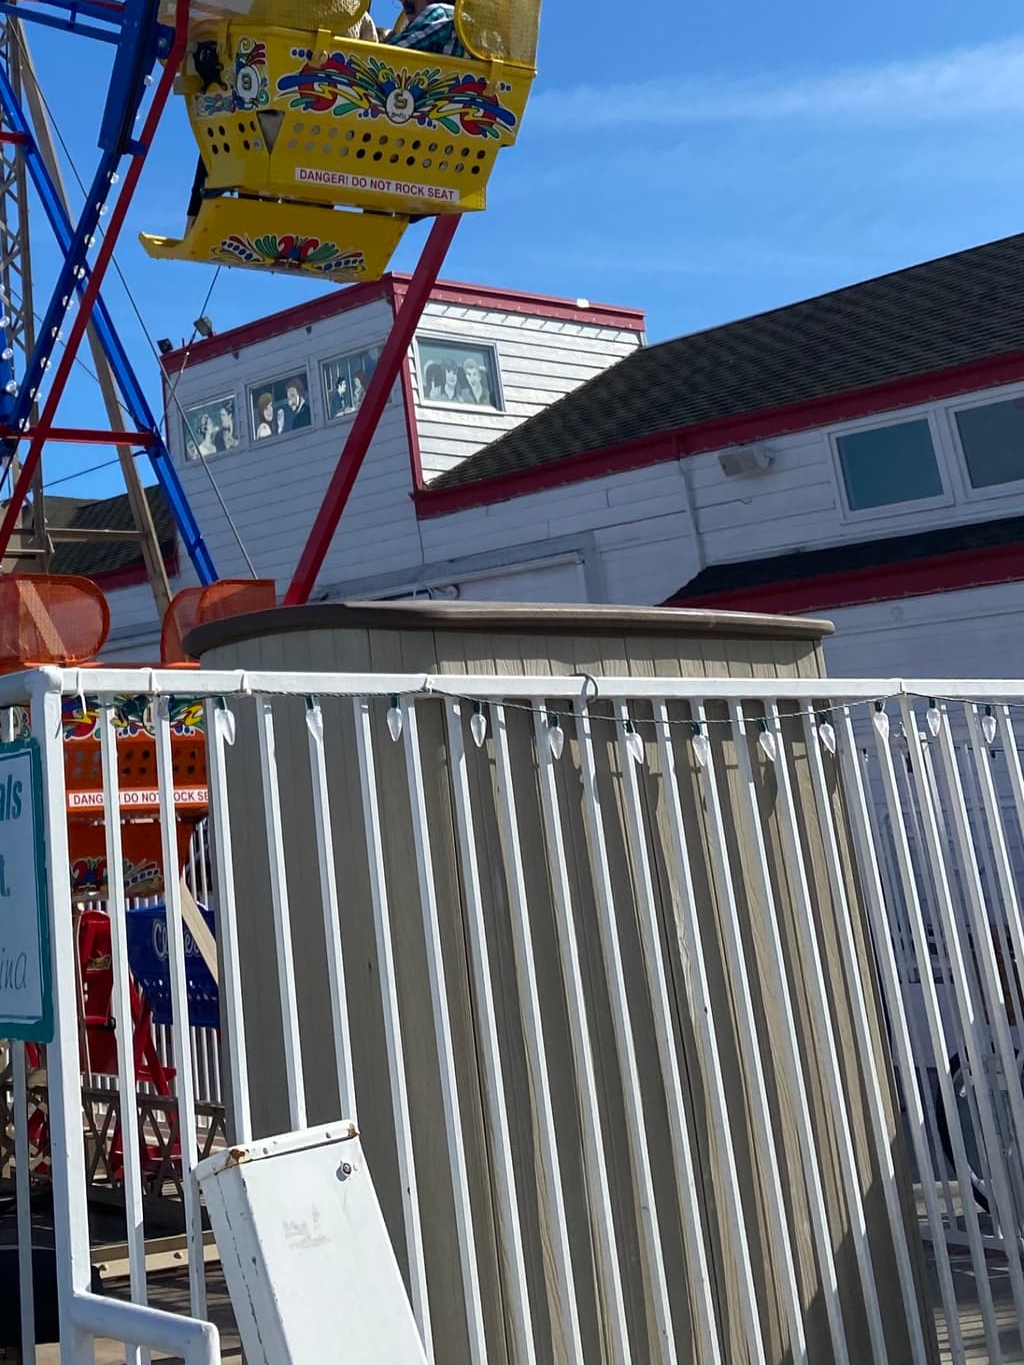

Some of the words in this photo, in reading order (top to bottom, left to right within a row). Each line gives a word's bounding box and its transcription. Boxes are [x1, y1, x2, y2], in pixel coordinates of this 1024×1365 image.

[299, 169, 349, 185] DANGER!
[351, 177, 367, 188] DO
[370, 179, 392, 191] NOT
[395, 183, 425, 197] ROCK
[427, 187, 455, 201] SEAT
[73, 793, 104, 805] DANG
[123, 792, 139, 803] DO
[174, 790, 195, 802] OCK
